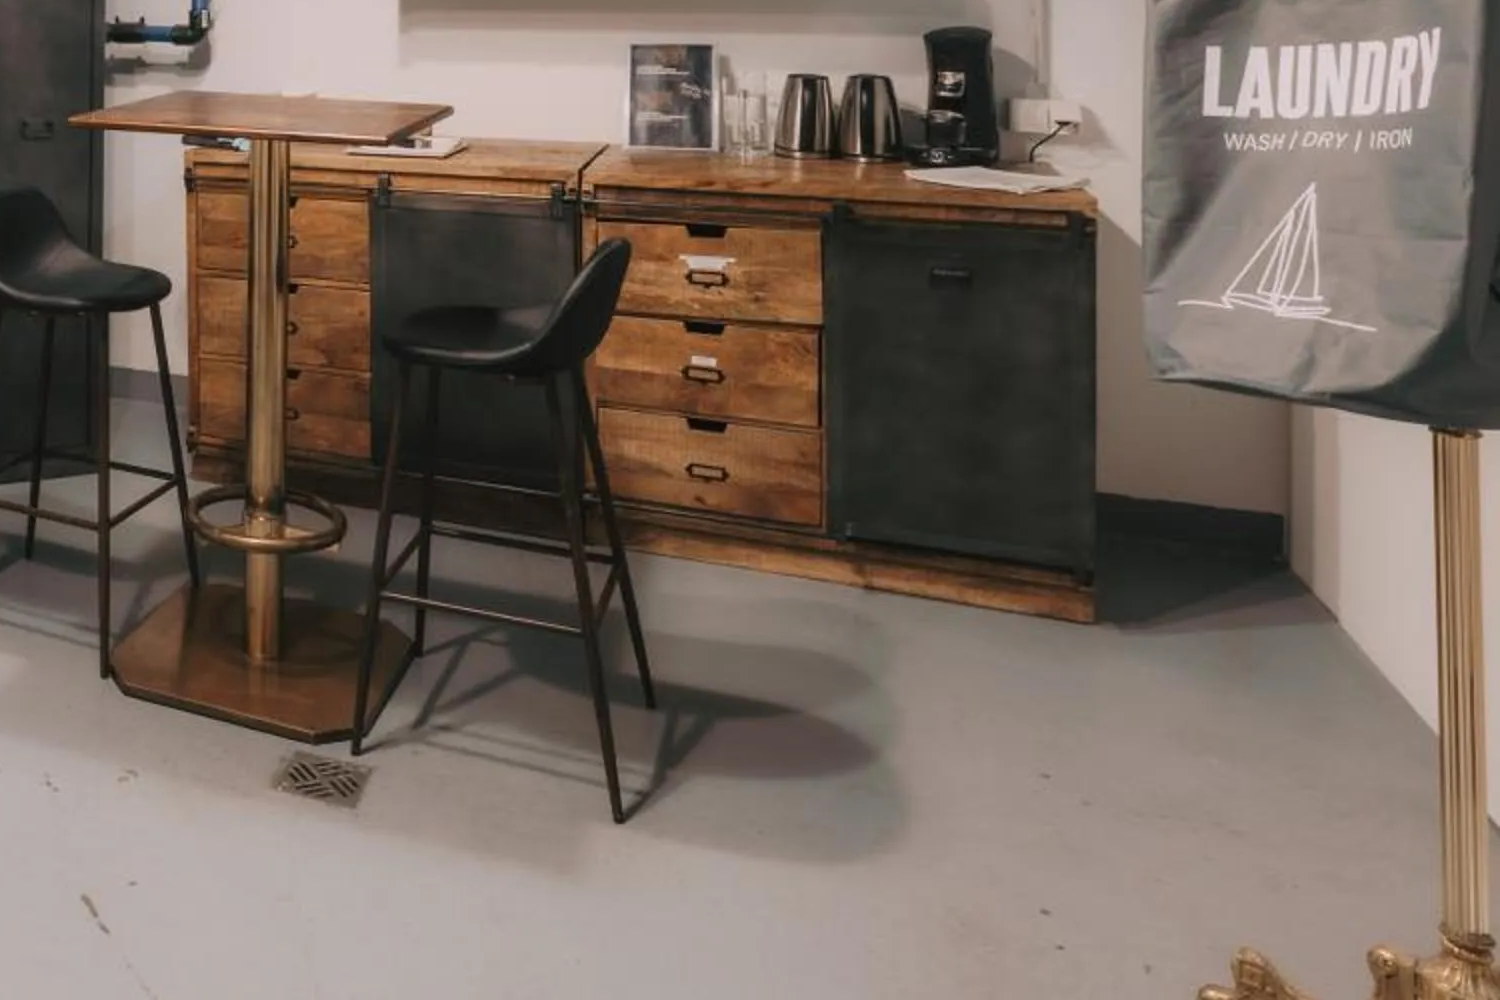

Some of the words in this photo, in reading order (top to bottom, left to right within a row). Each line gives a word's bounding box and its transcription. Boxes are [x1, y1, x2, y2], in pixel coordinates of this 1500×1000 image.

[1202, 27, 1441, 119] LAUNDRY
[1224, 131, 1285, 151] WASH
[1302, 130, 1348, 149] DRY
[1370, 127, 1413, 148] IRON
